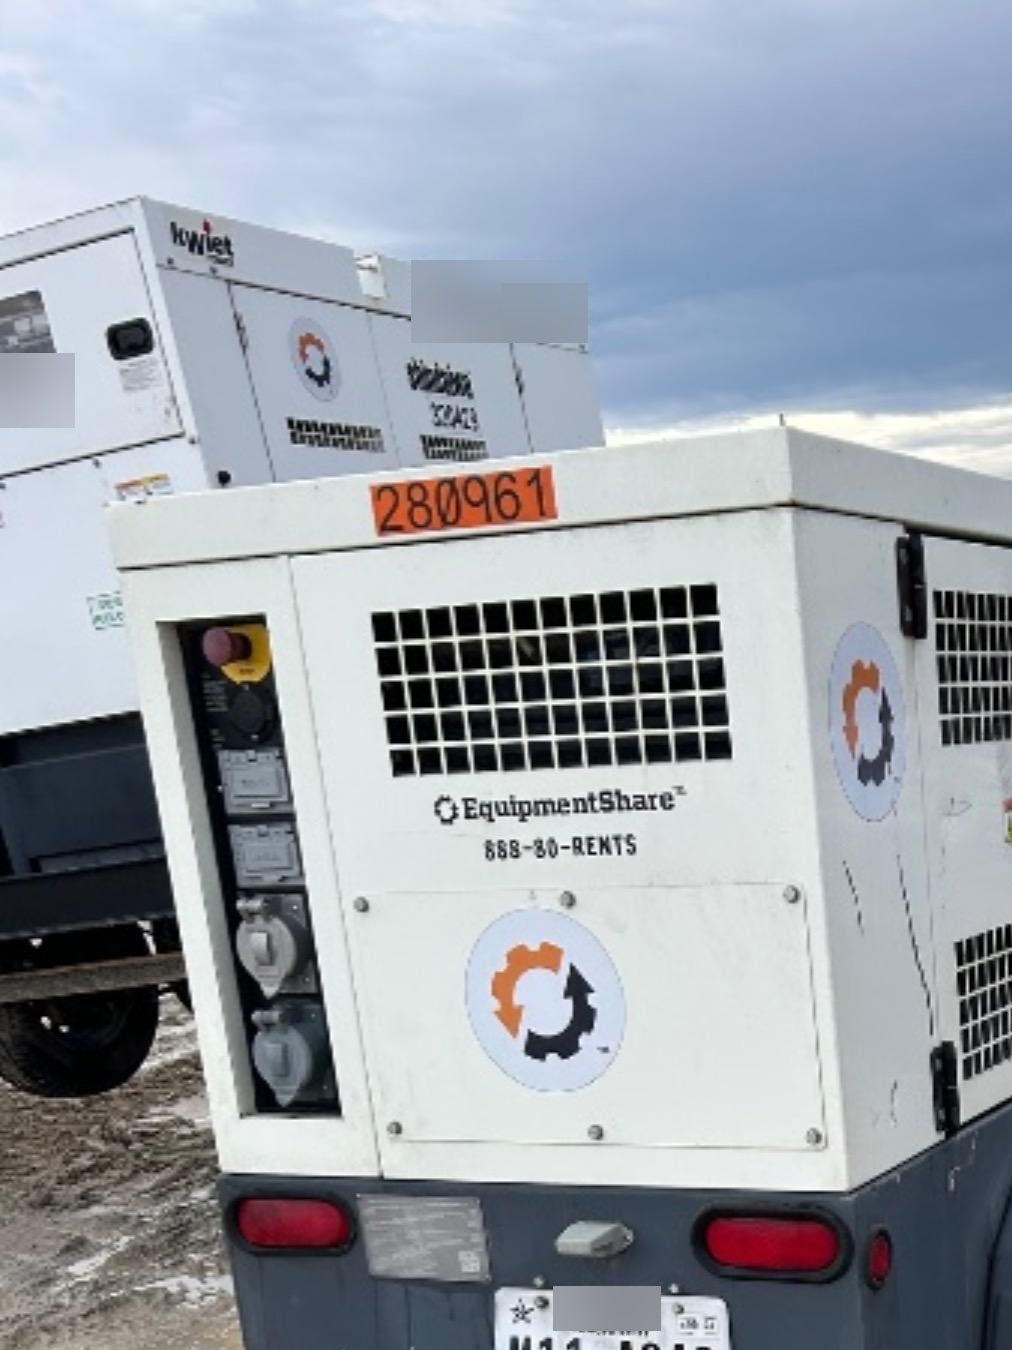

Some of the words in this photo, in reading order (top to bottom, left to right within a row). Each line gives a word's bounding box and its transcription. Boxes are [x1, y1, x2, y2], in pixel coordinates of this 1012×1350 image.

[377, 467, 548, 532] 280961
[461, 788, 677, 823] EquipmentShare
[483, 833, 638, 862] 888-80-RENTS
